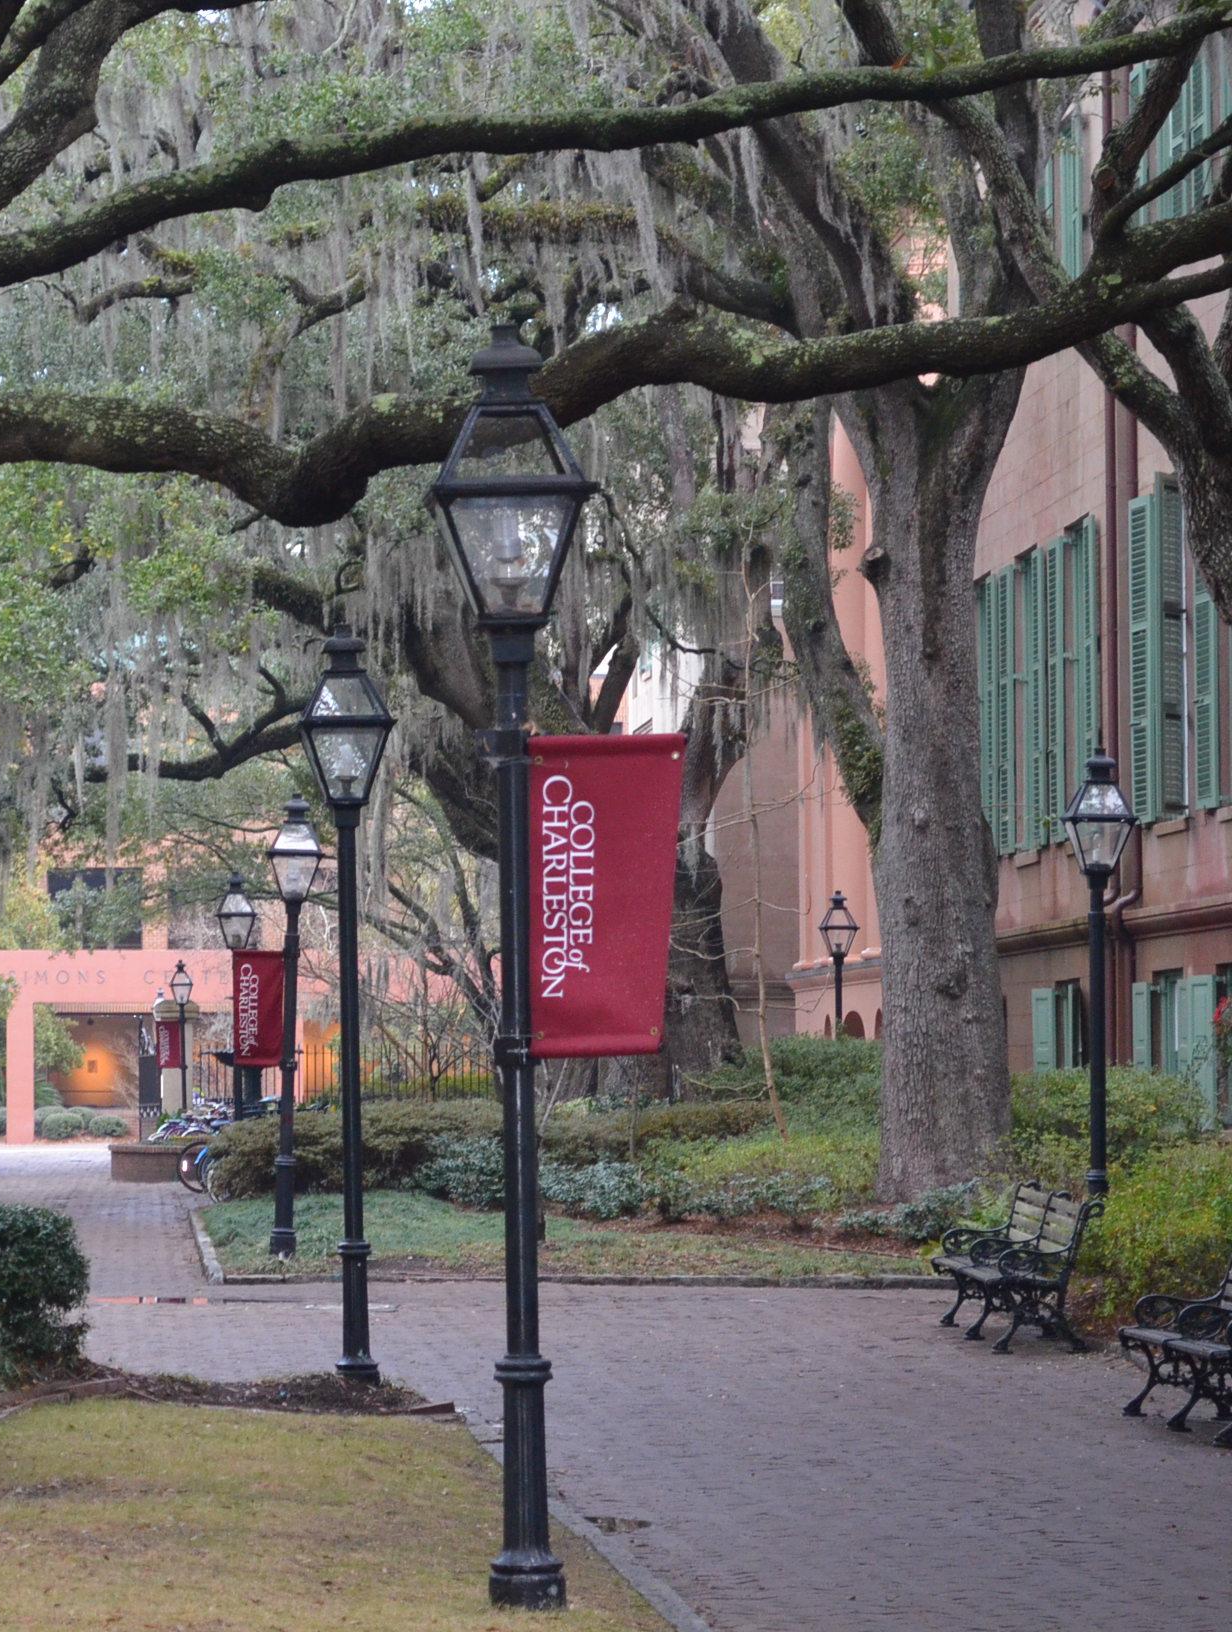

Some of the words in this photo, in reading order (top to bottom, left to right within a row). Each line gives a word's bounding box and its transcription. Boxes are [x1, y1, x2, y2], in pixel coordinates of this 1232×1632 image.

[540, 774, 573, 999] CHARLESTON
[569, 800, 596, 945] COLLEGE
[248, 974, 259, 1035] COLLEGE
[554, 948, 591, 973] of
[238, 963, 253, 1057] CHARLESTON
